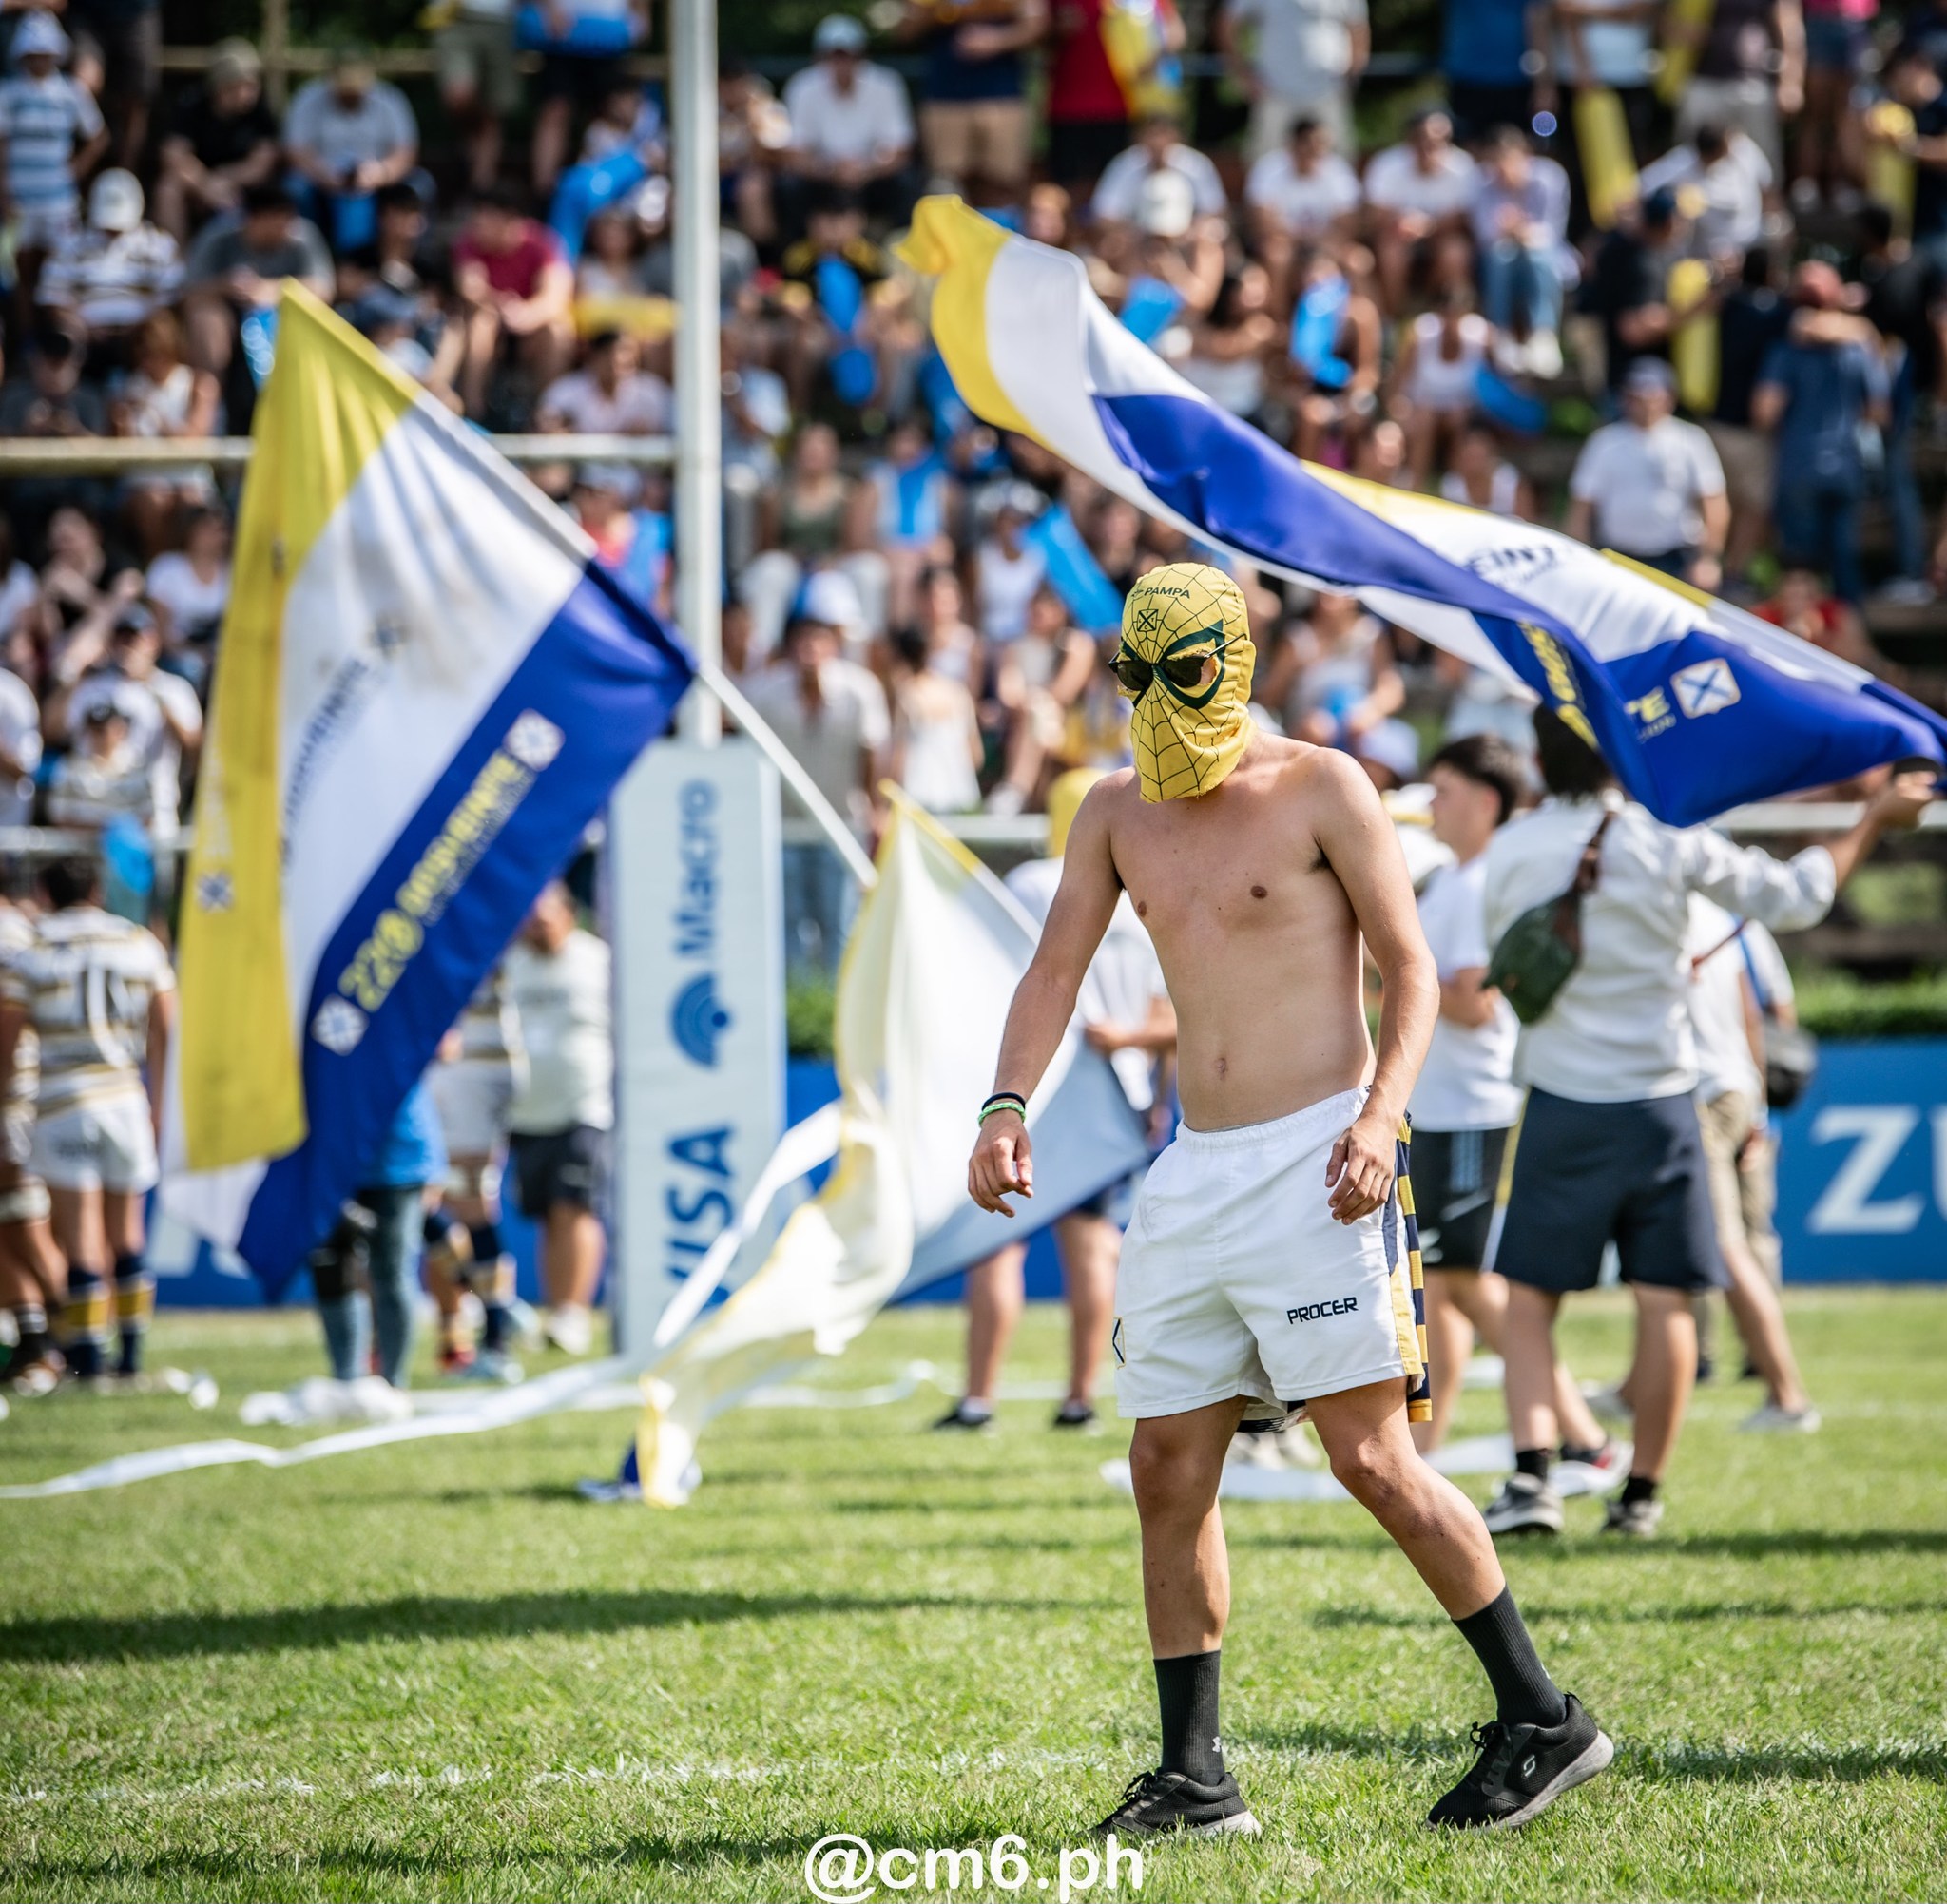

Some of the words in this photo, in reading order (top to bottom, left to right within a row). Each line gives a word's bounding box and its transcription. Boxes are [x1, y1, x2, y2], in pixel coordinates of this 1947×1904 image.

[1144, 587, 1190, 599] PAMPA
[672, 777, 720, 958] Macro
[1806, 1103, 1947, 1234] Z
[1286, 1297, 1359, 1325] PROCER
